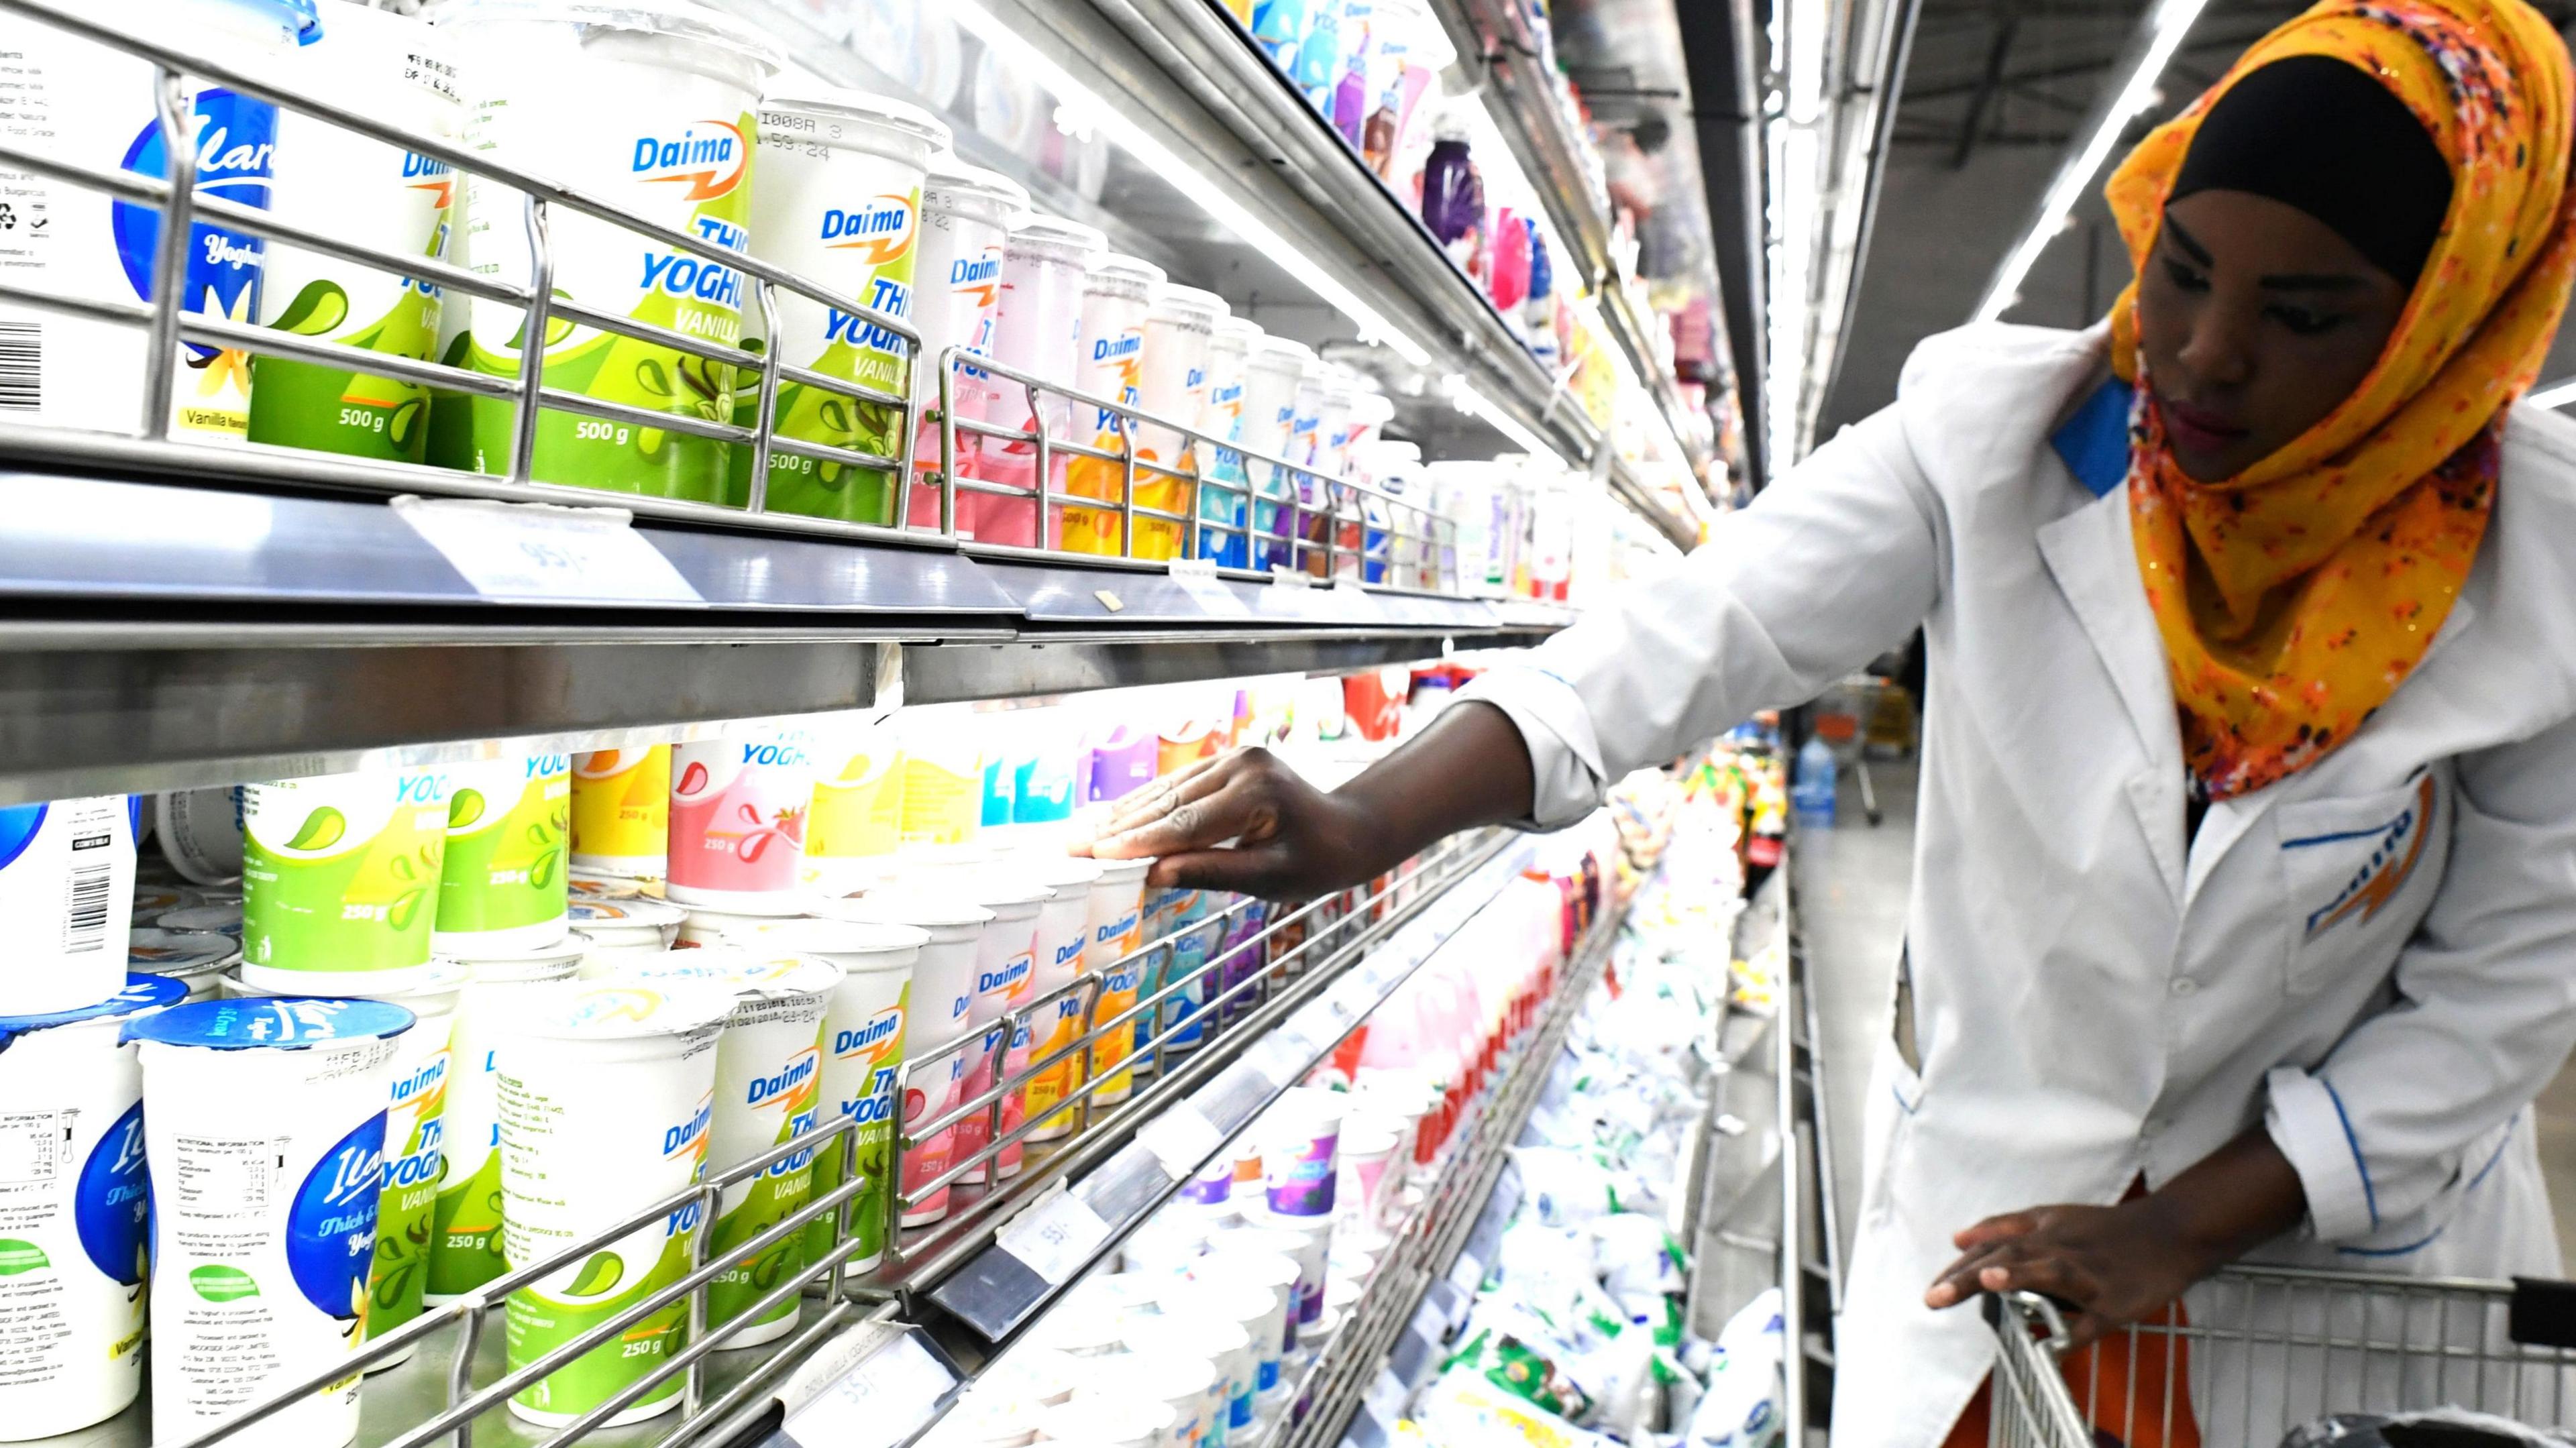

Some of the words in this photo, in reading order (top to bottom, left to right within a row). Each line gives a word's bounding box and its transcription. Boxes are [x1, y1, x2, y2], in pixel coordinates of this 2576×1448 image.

[633, 130, 733, 172] Daima
[821, 205, 904, 239] Daima
[186, 410, 226, 426] Vanilla
[339, 408, 372, 427] 500
[374, 416, 384, 433] g
[576, 421, 612, 440] 500
[616, 427, 629, 445] g
[769, 455, 800, 469] 500
[802, 459, 812, 474] g
[619, 810, 638, 819] 250
[704, 838, 725, 851] 250
[727, 840, 735, 853] g
[979, 959, 1029, 993] Daima
[835, 1019, 897, 1054] Daima
[749, 1054, 814, 1104] Daima
[318, 1211, 364, 1237] Thick
[447, 1235, 473, 1247] 250
[475, 1235, 486, 1249] g
[741, 1272, 749, 1284] g
[622, 1340, 650, 1357] 250
[651, 1340, 661, 1357] g
